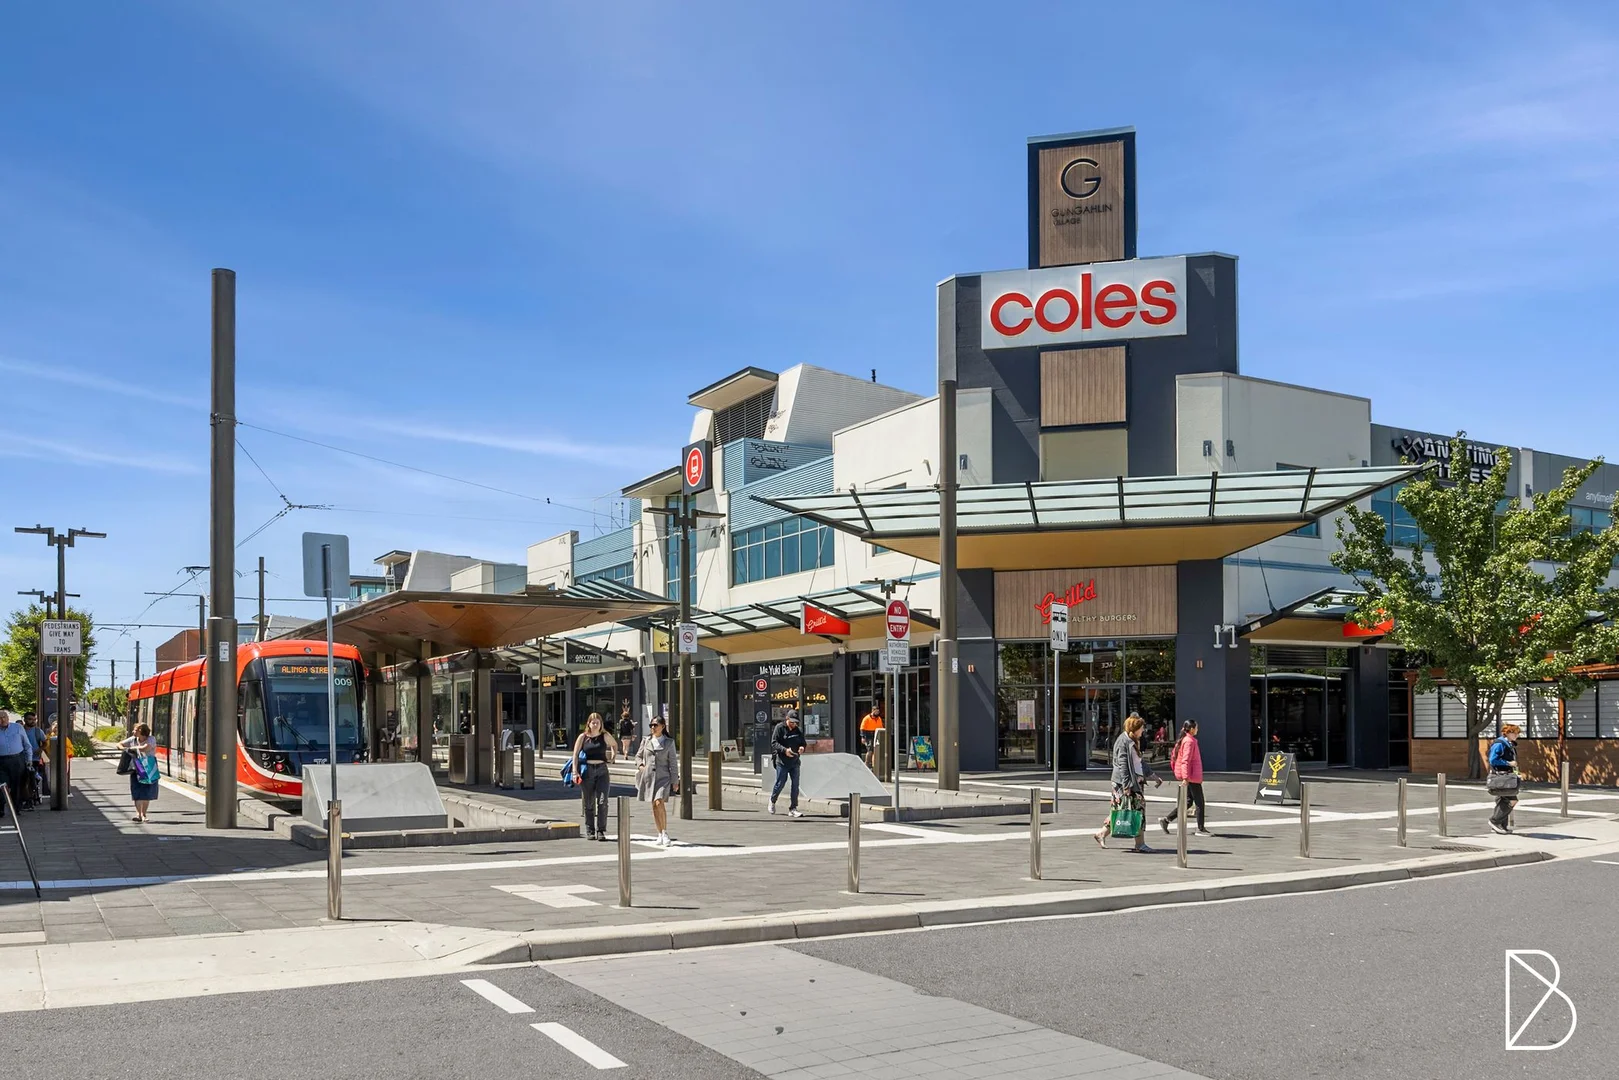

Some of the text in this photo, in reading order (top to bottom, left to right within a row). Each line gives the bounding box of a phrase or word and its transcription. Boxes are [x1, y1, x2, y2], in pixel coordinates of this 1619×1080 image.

[1060, 157, 1102, 199] G
[1051, 203, 1113, 218] GUNGAHLIN
[989, 272, 1178, 337] coles
[893, 606, 902, 615] NO
[1099, 614, 1137, 622] BURGERS
[44, 622, 80, 630] PEDESTRIANS
[889, 624, 907, 633] ENTRY
[1052, 630, 1067, 641] ONLY
[281, 665, 337, 674] ALINGA STRET
[781, 663, 802, 677] Bakery
[334, 677, 353, 687] 009
